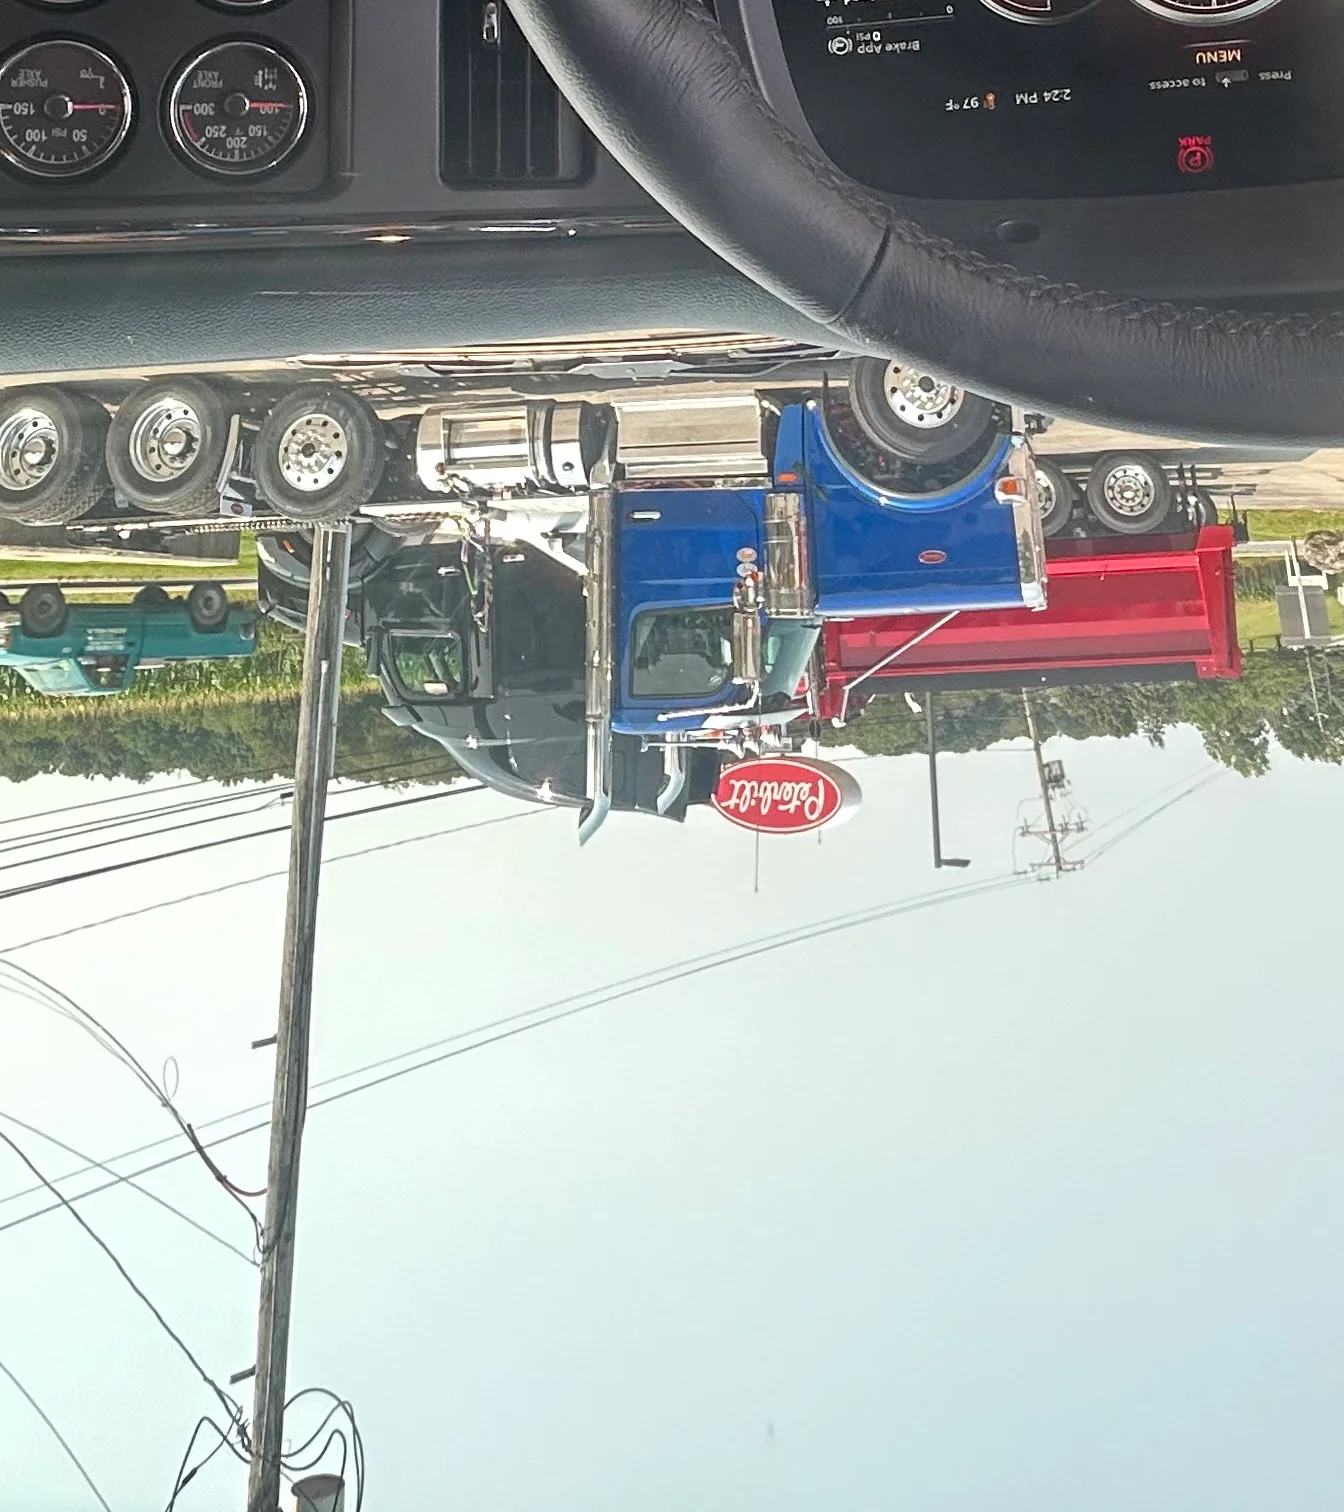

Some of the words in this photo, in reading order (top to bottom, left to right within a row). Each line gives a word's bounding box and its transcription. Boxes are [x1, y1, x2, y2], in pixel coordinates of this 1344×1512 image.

[826, 14, 844, 25] 100
[855, 31, 871, 42] PSI
[872, 30, 881, 41] 0
[856, 42, 882, 54] APP
[884, 39, 921, 52] Brake
[1194, 48, 1242, 64] MENU
[18, 69, 42, 79] AXLE
[196, 70, 219, 79] AXLE
[1258, 69, 1291, 82] Press
[11, 78, 48, 88] PUSHER
[192, 78, 223, 88] FRONT
[1147, 78, 1190, 91] access
[1192, 77, 1206, 88] to
[1015, 91, 1038, 104] PM
[1043, 88, 1071, 103] 2:24
[962, 96, 980, 109] 97
[13, 103, 34, 115] 150
[193, 103, 215, 115] 300
[25, 128, 47, 141] 100
[51, 127, 67, 137] PSI
[72, 129, 87, 141] 50
[205, 125, 227, 137] 250
[248, 124, 267, 136] 150
[226, 136, 247, 148] 200
[1178, 135, 1211, 147] PARK
[720, 779, 825, 821] Peterbilt
